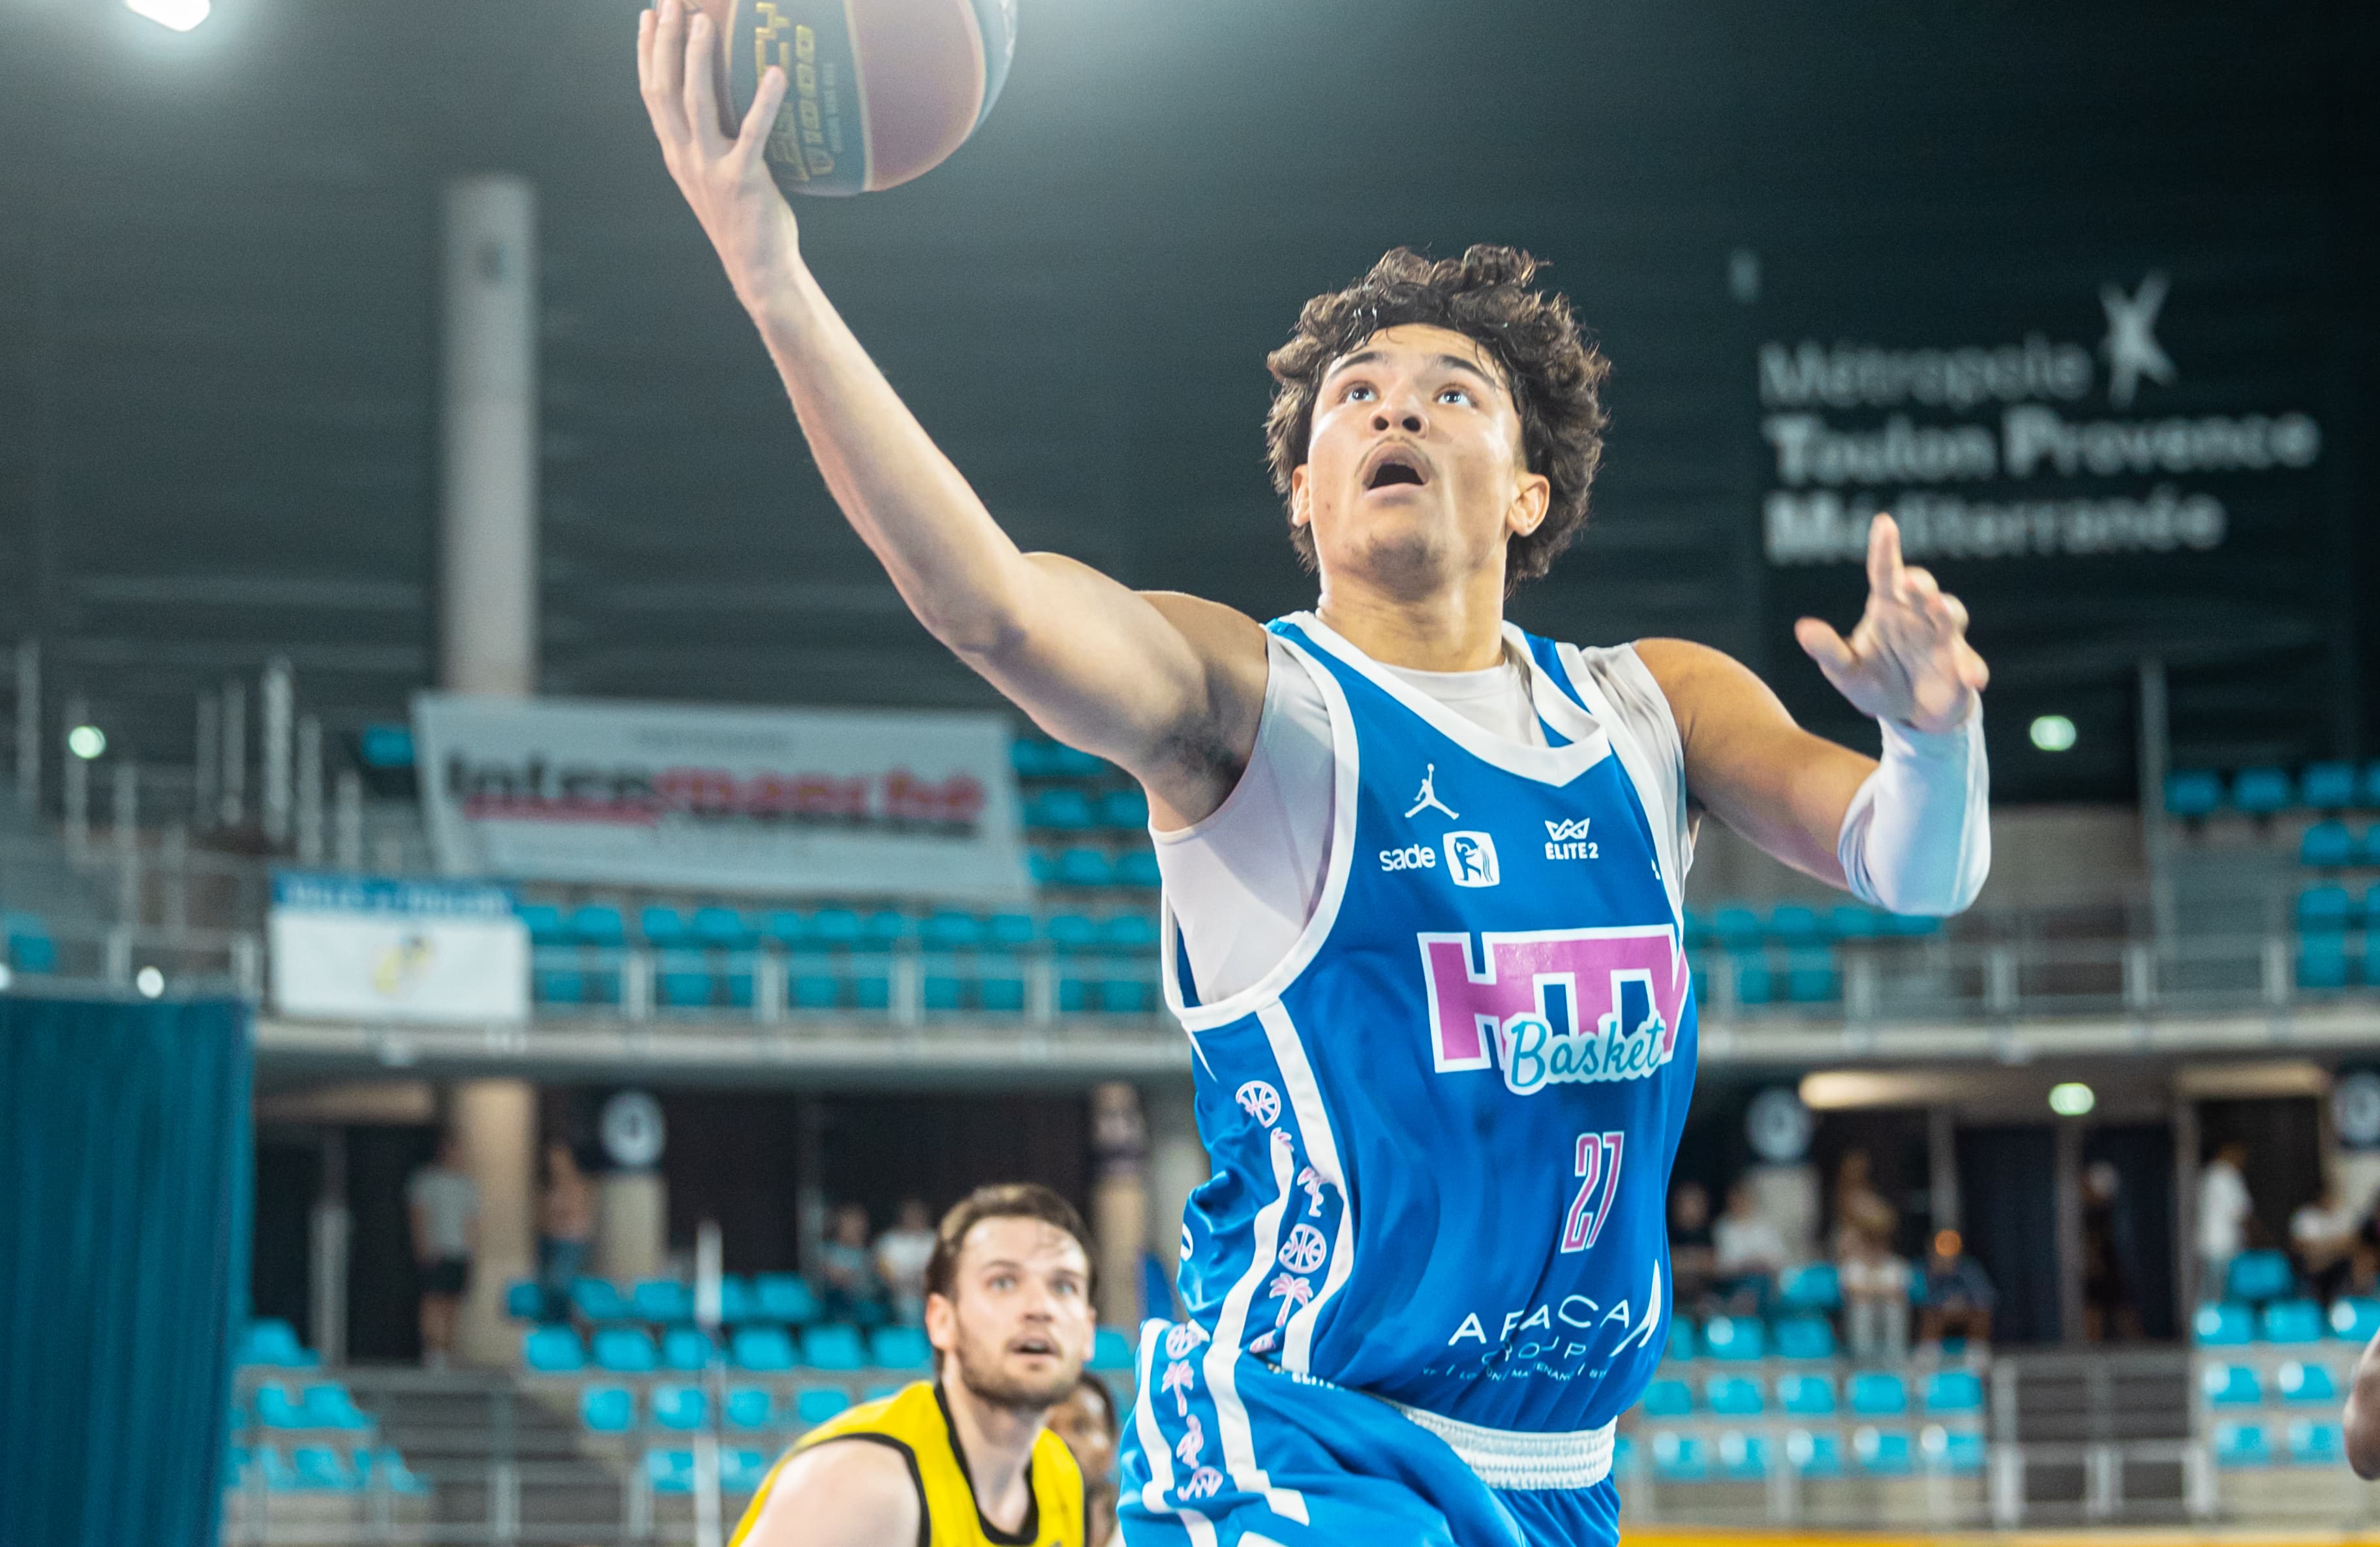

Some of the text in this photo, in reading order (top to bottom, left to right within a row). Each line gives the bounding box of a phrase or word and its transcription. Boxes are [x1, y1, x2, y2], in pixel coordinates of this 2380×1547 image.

[1763, 402, 2321, 485] Toulon Provence
[1379, 844, 1435, 872] sade
[1506, 1015, 1666, 1094] Basket
[1561, 1131, 1625, 1253] 27
